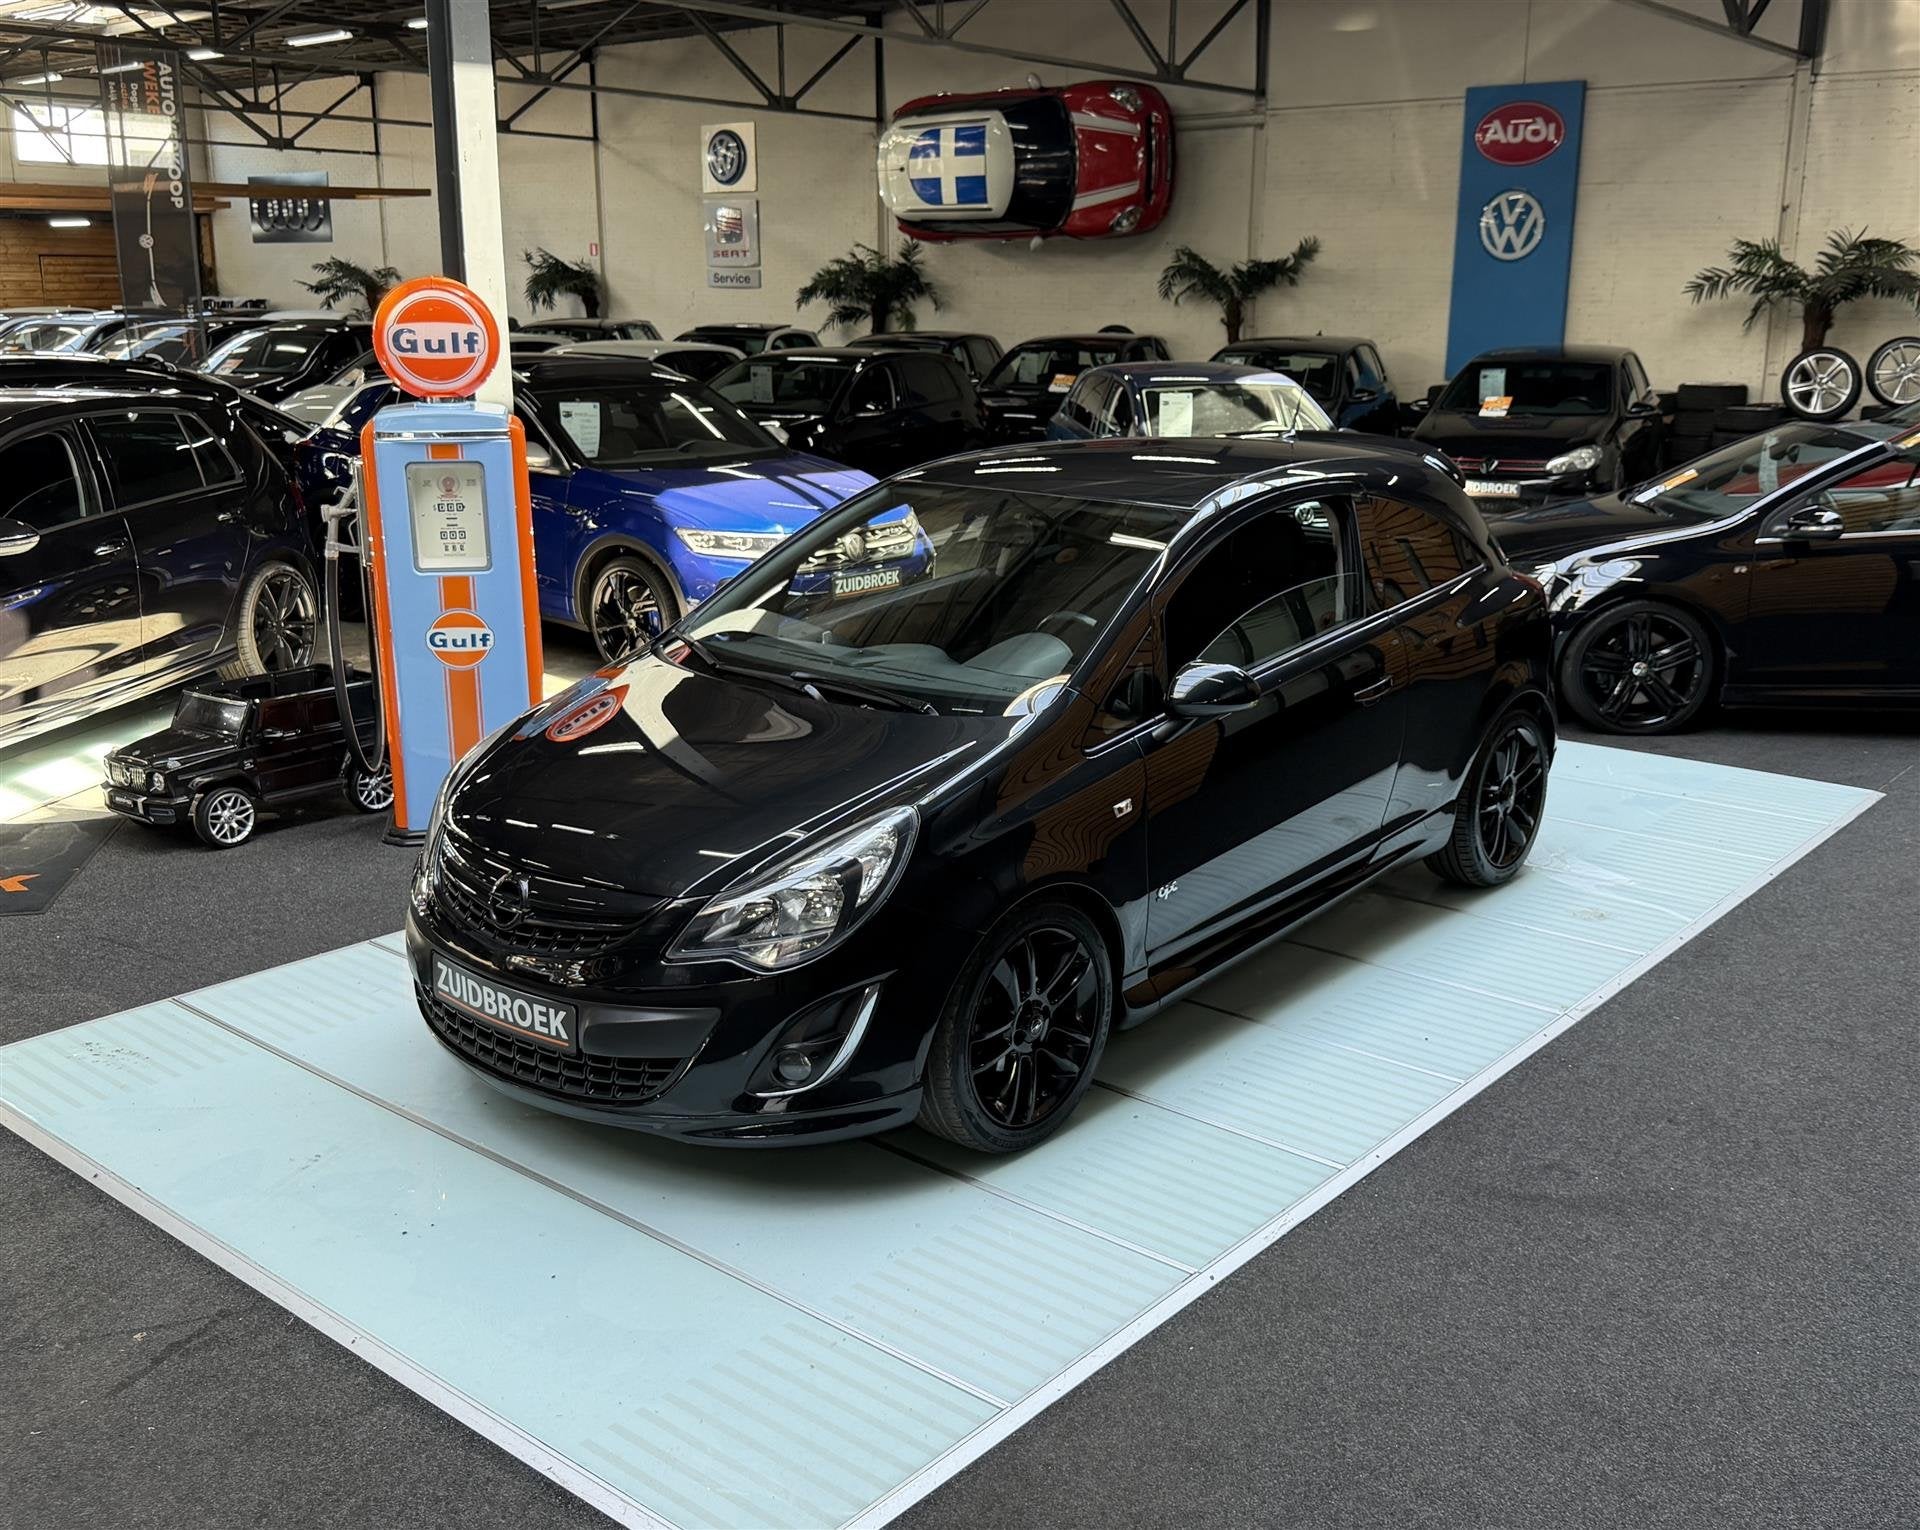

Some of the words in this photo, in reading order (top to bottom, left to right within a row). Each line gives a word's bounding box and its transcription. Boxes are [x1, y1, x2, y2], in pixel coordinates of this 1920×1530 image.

[713, 249, 750, 258] SEAT
[713, 273, 751, 284] Service
[392, 328, 479, 354] Gulf
[835, 570, 900, 594] ZUIDBROEK
[429, 631, 490, 648] Gulf
[437, 961, 569, 1040] ZUIDBROEK
